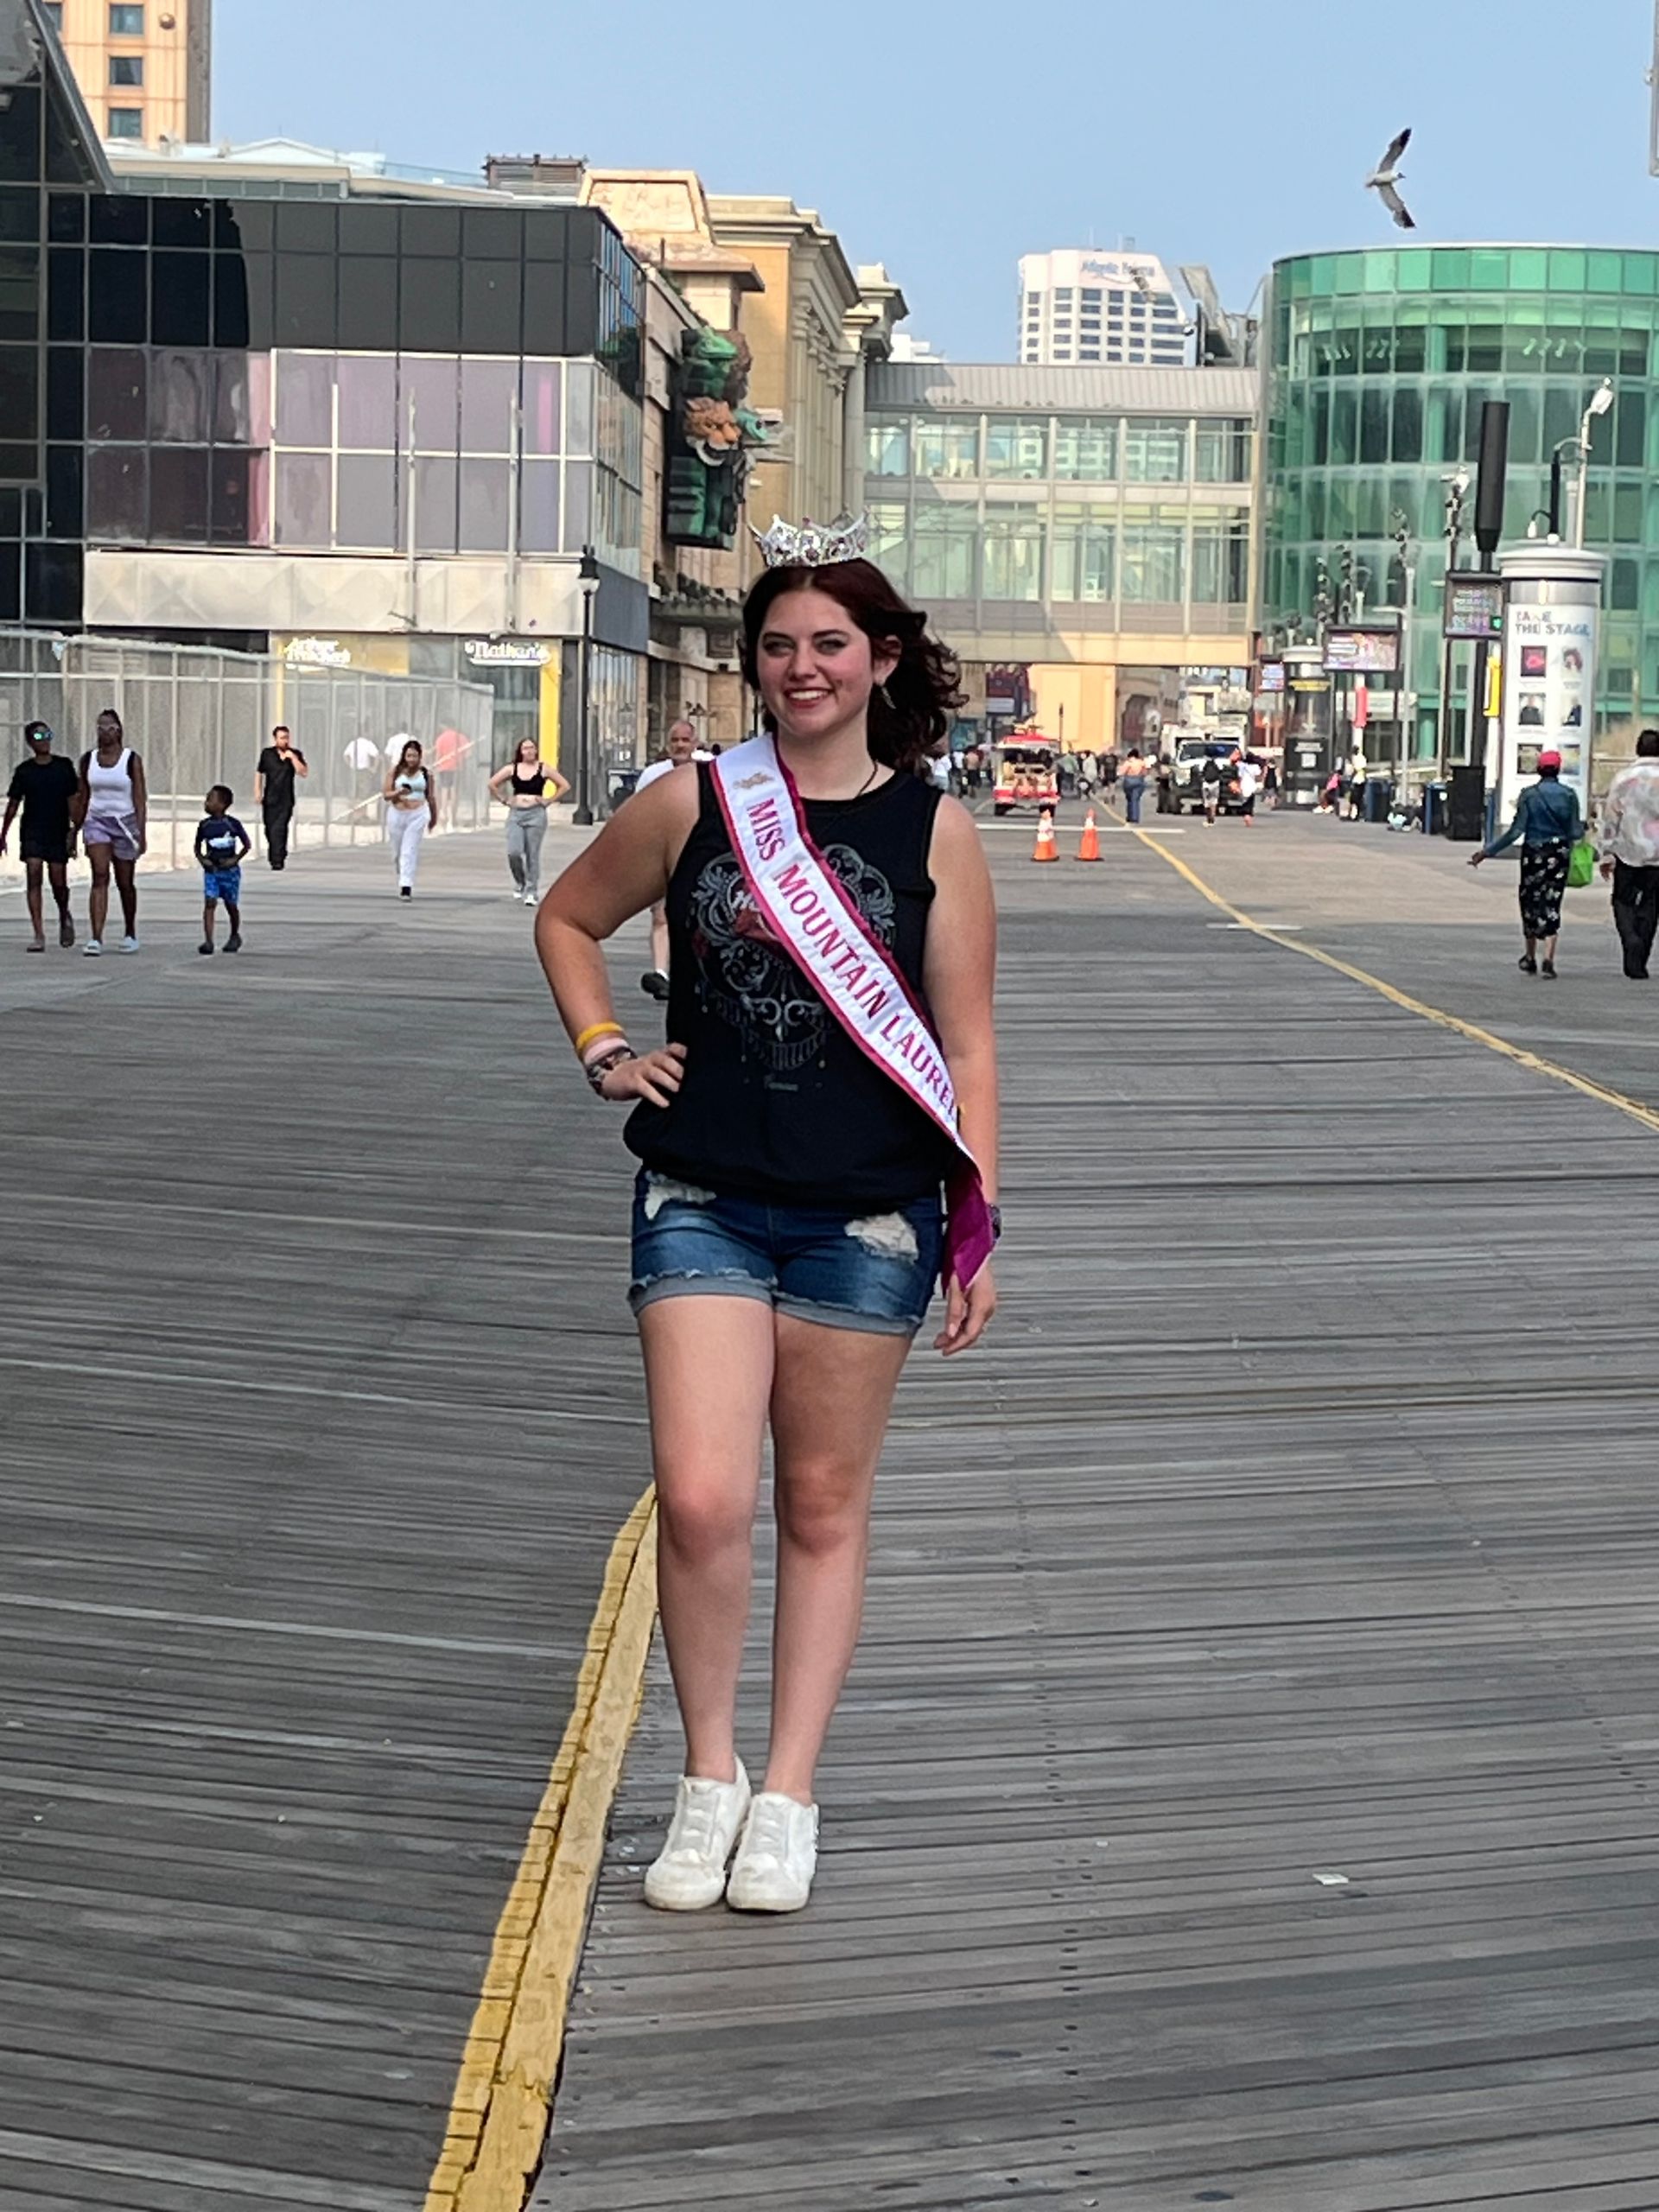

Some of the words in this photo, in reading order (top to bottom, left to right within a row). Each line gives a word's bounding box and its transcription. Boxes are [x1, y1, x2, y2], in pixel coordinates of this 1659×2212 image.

[1516, 623, 1541, 634] THE
[747, 798, 785, 861] MISS
[773, 864, 891, 1020] MOUNTAIN
